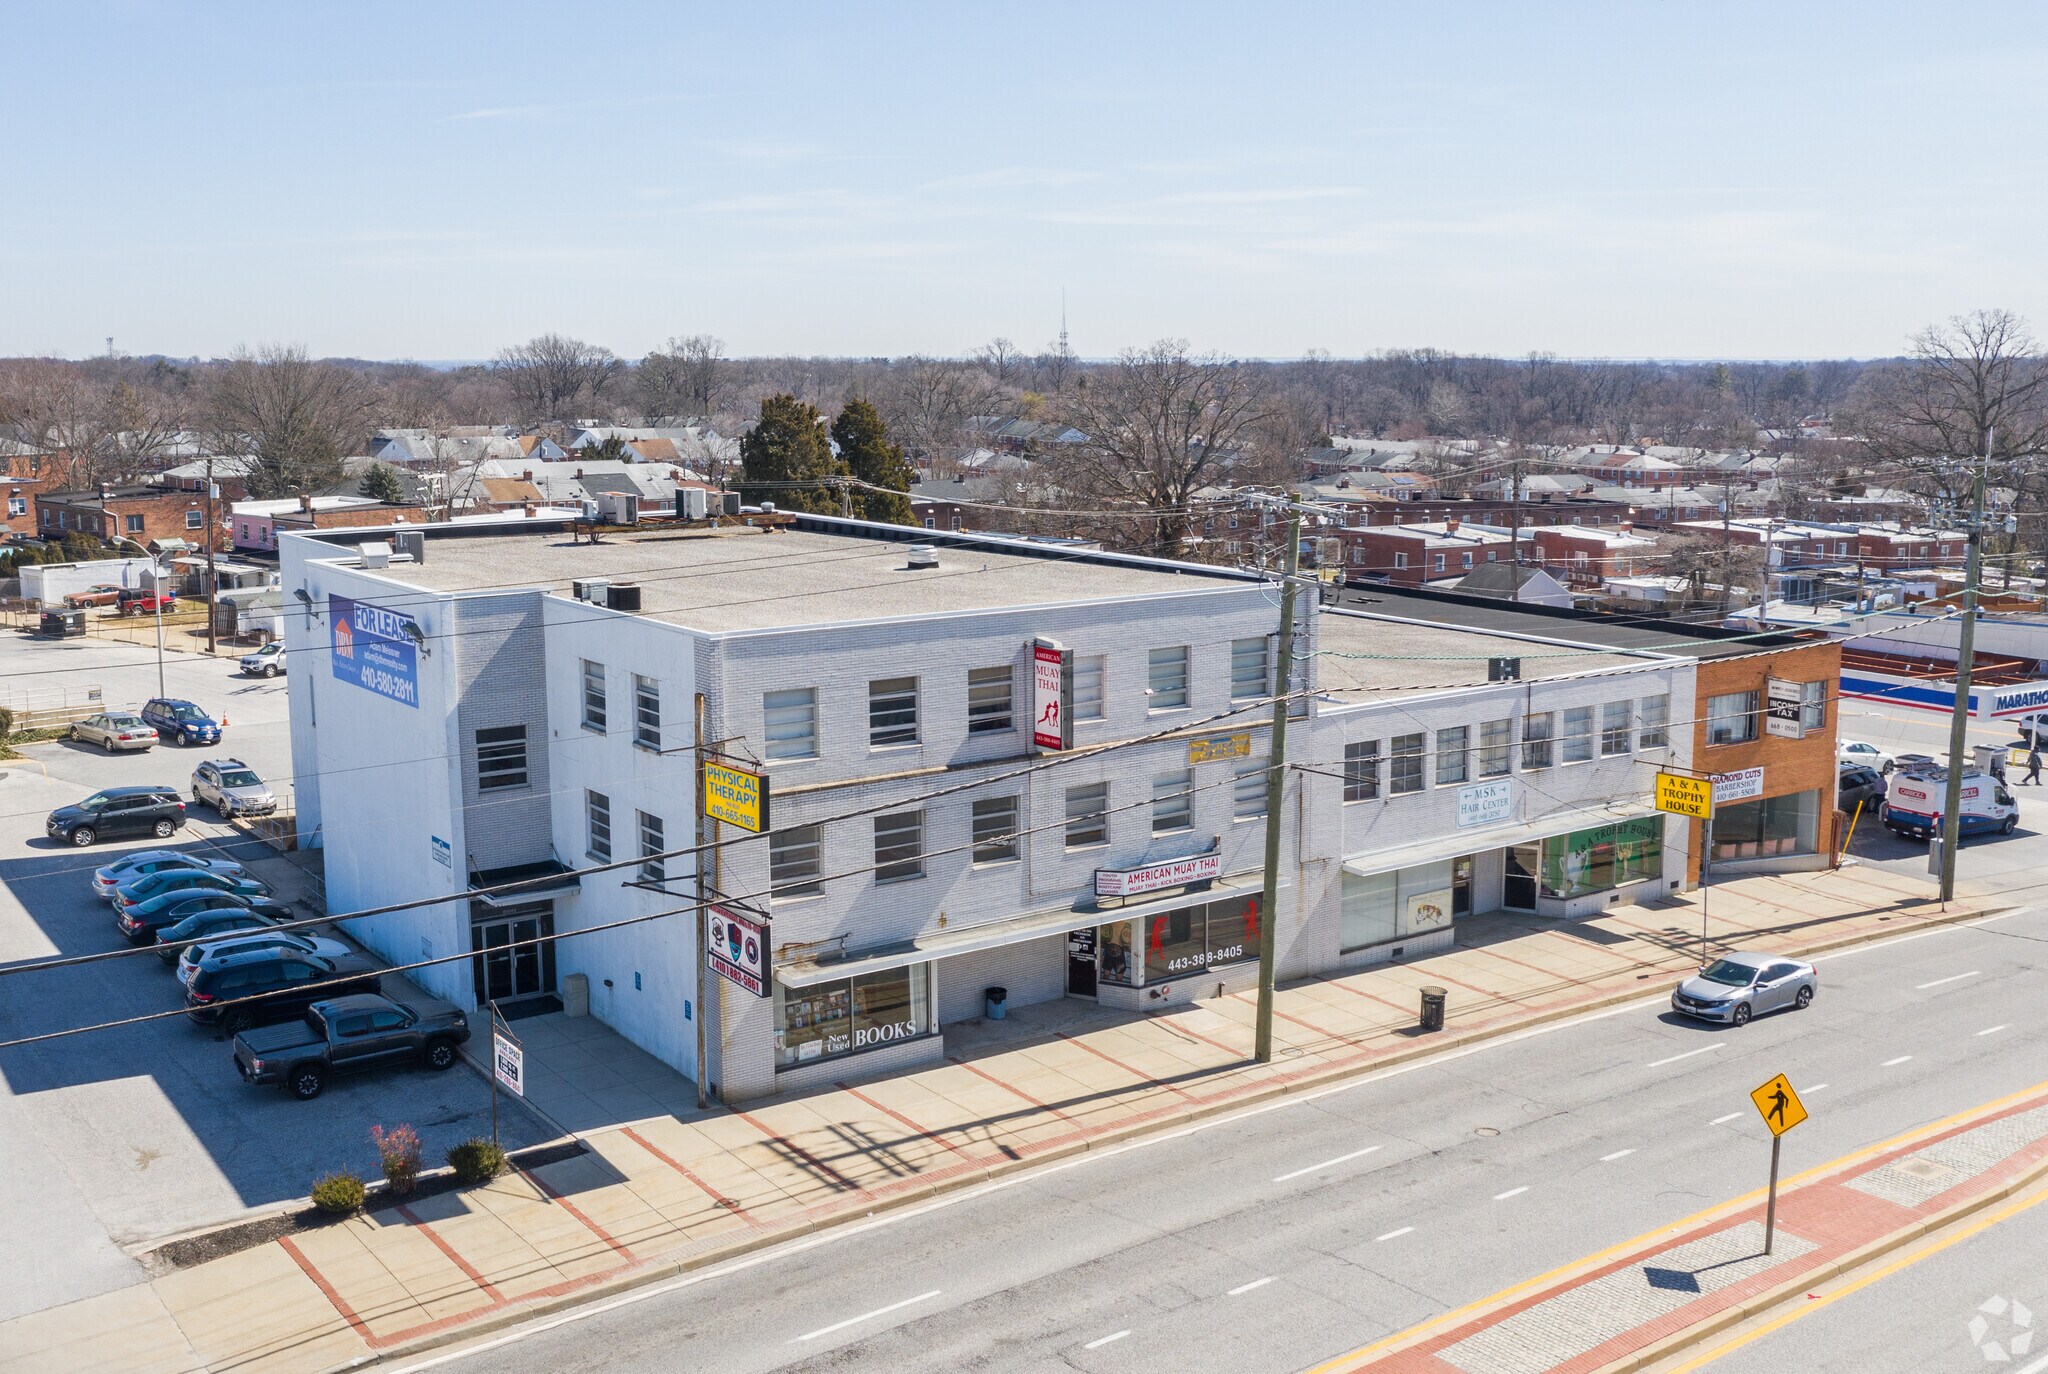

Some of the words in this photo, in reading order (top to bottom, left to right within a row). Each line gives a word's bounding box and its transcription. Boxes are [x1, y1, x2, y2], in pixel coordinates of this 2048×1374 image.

[355, 605, 376, 632] FOR
[336, 630, 354, 659] DBM
[369, 640, 382, 653] Adam
[382, 643, 400, 658] Meissner
[1036, 652, 1060, 661] AMERICAN
[1036, 665, 1060, 678] MUAY
[361, 665, 414, 703] 410-580-2811
[1038, 678, 1058, 691] THAI
[1770, 700, 1799, 711] INCOME
[1996, 690, 2048, 710] MARATHO
[1777, 709, 1792, 717] TAX
[708, 766, 758, 793] PHYSICAL
[1668, 778, 1675, 787] A
[1680, 780, 1688, 789] &
[1692, 782, 1699, 791] A
[1713, 772, 1743, 784] DIAMOND
[1744, 769, 1762, 779] CUTS
[709, 782, 756, 807] THERAPY
[1474, 787, 1496, 800] MSK
[1716, 779, 1758, 793] BARBERSHOP
[1716, 788, 1756, 801] 410-661-5508
[1662, 788, 1706, 804] TROPHY
[1461, 803, 1479, 814] HAIR
[1482, 797, 1509, 810] CENTER
[1665, 800, 1702, 815] HOUSE
[711, 804, 755, 828] 410-665-1165
[1575, 848, 1581, 859] A
[1588, 838, 1594, 847] A
[1595, 823, 1628, 841] TROPHY
[1631, 824, 1658, 841] HOUSE
[1127, 867, 1171, 885] AMERICAN
[1174, 862, 1197, 875] MUAY
[1199, 857, 1219, 869] THAI
[1129, 884, 1143, 892] MUAY
[1145, 882, 1157, 890] THAI
[1160, 878, 1173, 887] KICK
[1174, 874, 1194, 884] BOXING
[1197, 869, 1216, 880] BOXING
[1168, 945, 1242, 971] 443-388-8405
[712, 957, 728, 974] (410)
[730, 967, 759, 993] 882-5861
[829, 1034, 849, 1043] New
[855, 1020, 916, 1047] BOOKS
[495, 1036, 507, 1052] OFFICE
[508, 1046, 520, 1062] SPACE
[827, 1040, 850, 1053] Used
